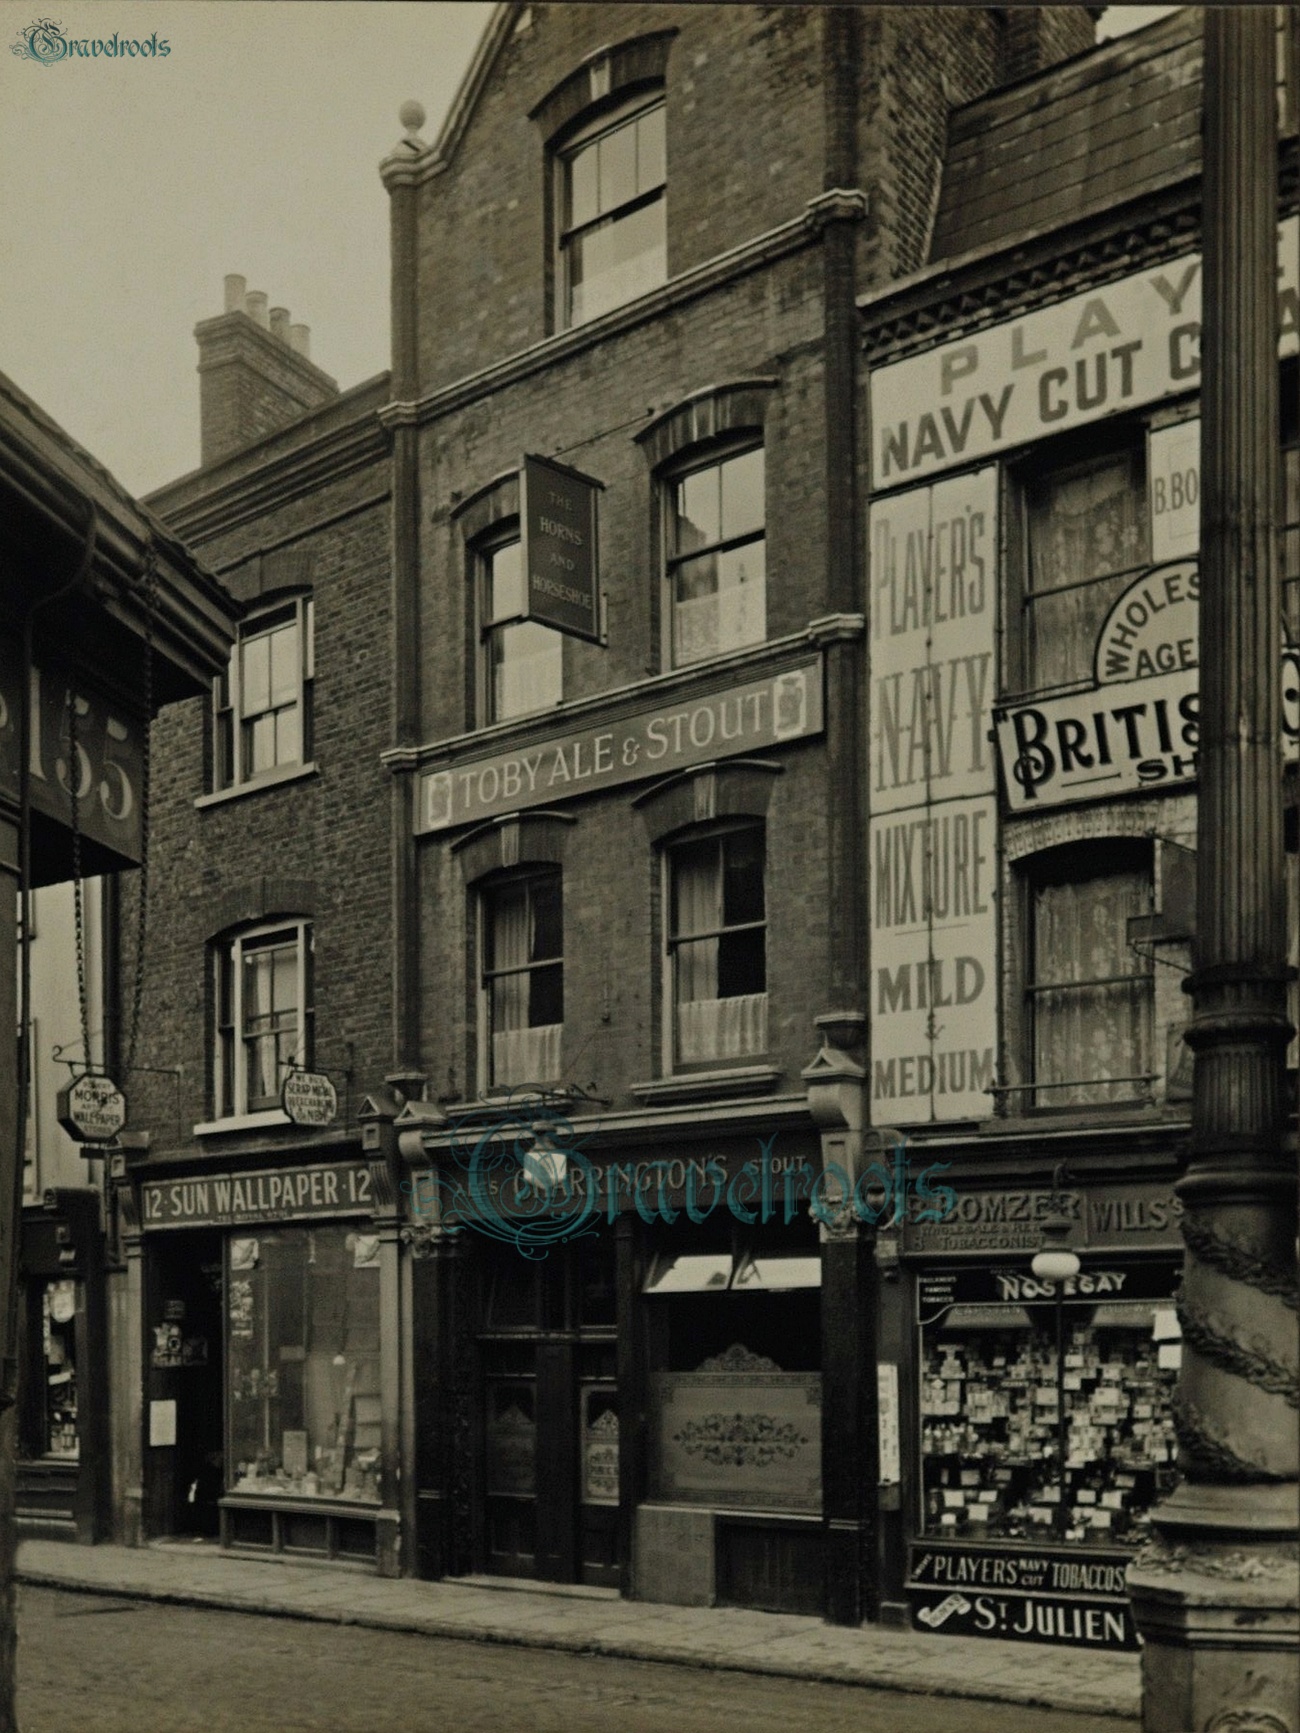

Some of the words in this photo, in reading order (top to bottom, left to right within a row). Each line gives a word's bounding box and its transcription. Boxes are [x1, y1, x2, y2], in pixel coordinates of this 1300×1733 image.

[882, 384, 1014, 476] NAVY
[1039, 340, 1142, 424] CUT
[549, 492, 573, 511] THE
[540, 517, 584, 546] HORNS
[551, 552, 575, 571] AND
[875, 505, 985, 640] PLAYER'S
[532, 575, 592, 609] HORSESHOE
[875, 652, 992, 792] NAVY
[459, 755, 544, 808] TOBY
[548, 733, 613, 786] ALE
[622, 738, 640, 766] &
[646, 690, 769, 759] STOUT
[875, 810, 987, 929] MIXTURE
[877, 956, 984, 1016] MILD
[874, 1048, 994, 1101] MEDIUM
[145, 1189, 162, 1218] 12
[170, 1183, 209, 1216] SUN
[214, 1172, 340, 1213] WALLPAPER
[349, 1169, 372, 1202] 12
[514, 1154, 728, 1200] CARRINGTON'S
[749, 1155, 807, 1175] STOUT
[934, 1555, 1018, 1585] PLAYER'S
[1019, 1558, 1050, 1572] NAVY
[1020, 1574, 1045, 1586] CUT
[1052, 1562, 1126, 1593] TOBACCOS
[1013, 1599, 1126, 1643] JULIEN
